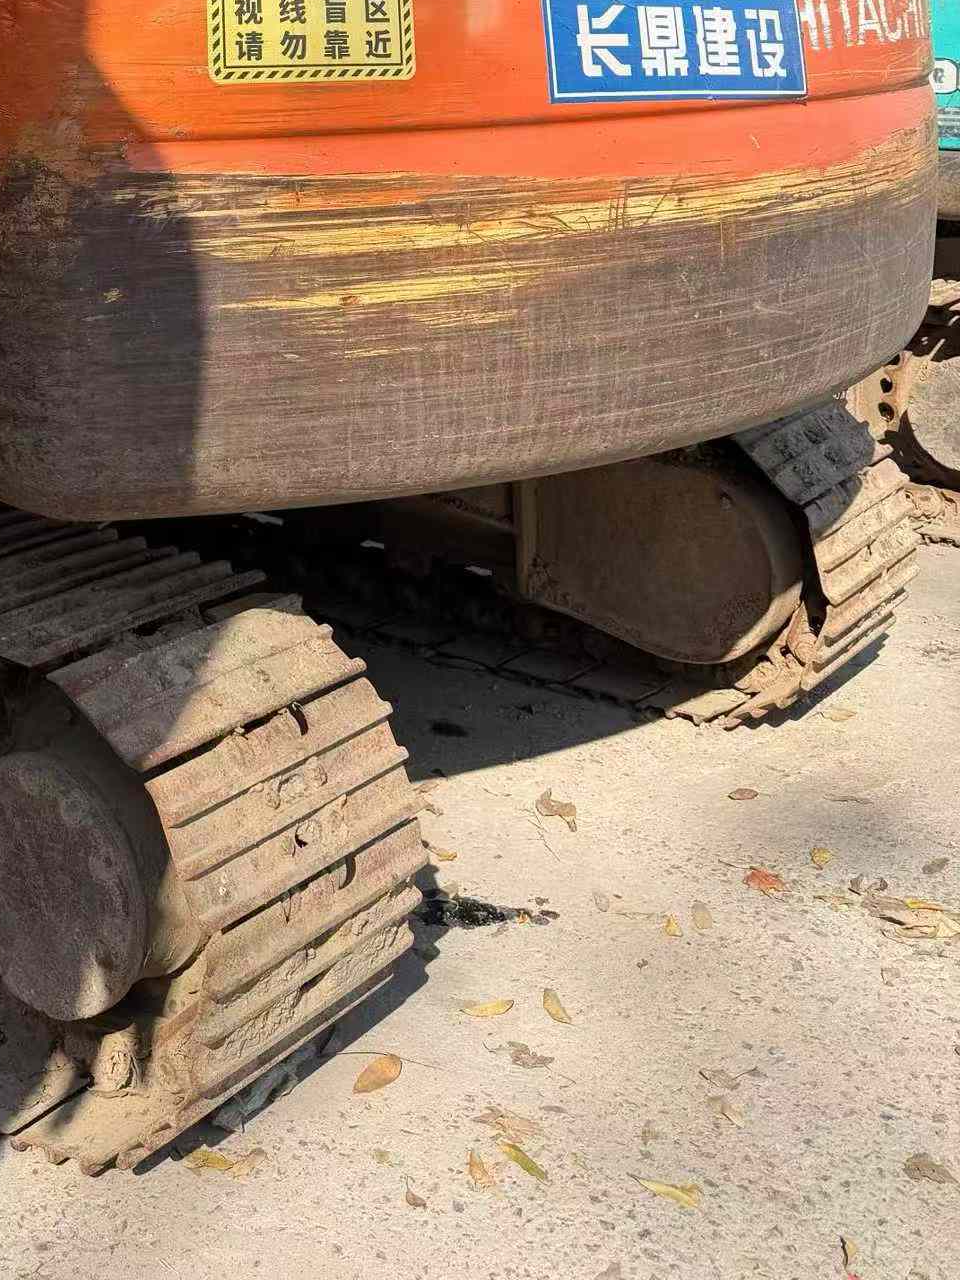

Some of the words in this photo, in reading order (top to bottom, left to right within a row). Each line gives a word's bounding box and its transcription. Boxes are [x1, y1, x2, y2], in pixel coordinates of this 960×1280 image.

[235, 30, 392, 61] 请勿靠近
[576, 4, 787, 78] 长鼎建设
